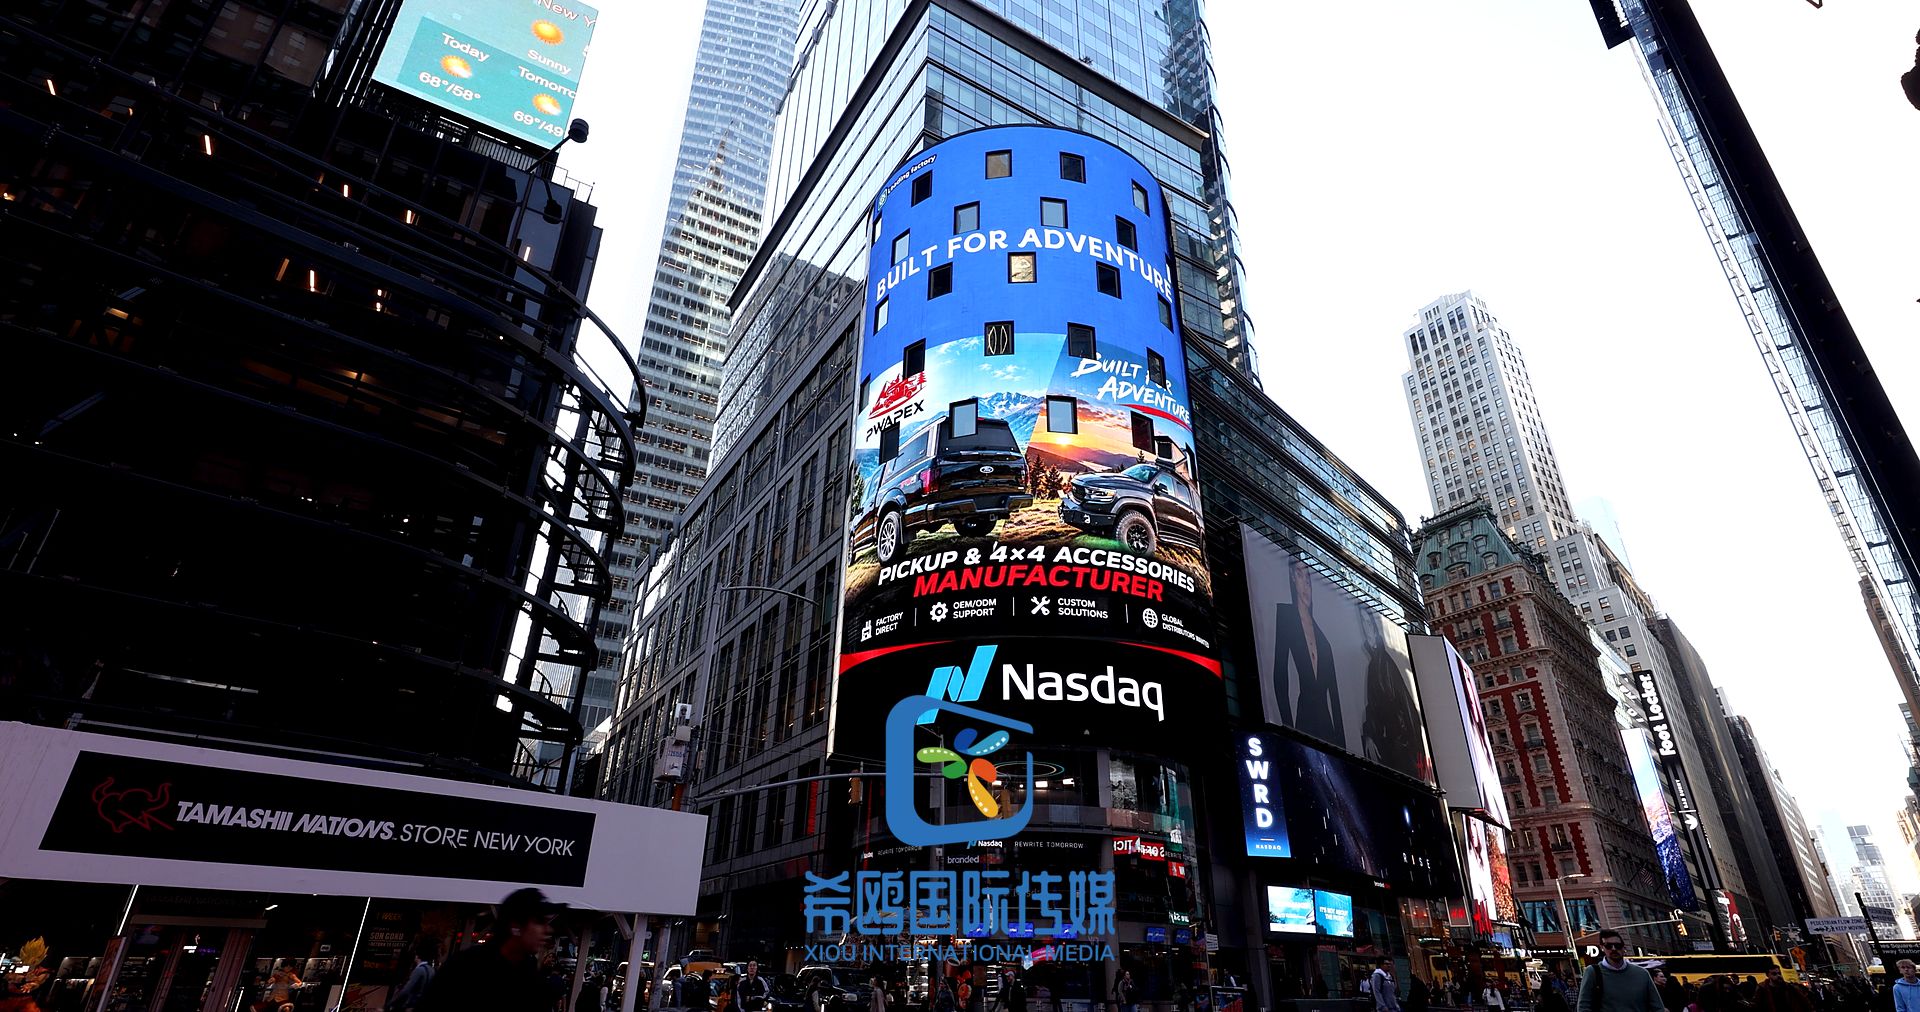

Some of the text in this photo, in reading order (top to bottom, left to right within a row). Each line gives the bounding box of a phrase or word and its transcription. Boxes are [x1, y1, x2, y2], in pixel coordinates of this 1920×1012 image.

[537, 0, 579, 20] New
[442, 33, 490, 62] Today
[527, 49, 571, 75] Sunny
[418, 71, 481, 101] 68°/58°
[911, 155, 936, 173] factory
[876, 228, 1173, 303] BUILT FOR ADVENTURE
[1096, 376, 1190, 424] ADVENTURE
[877, 550, 958, 586] PICKUP
[964, 548, 981, 566] &
[1052, 545, 1195, 593] ACCESSORIES
[913, 564, 1165, 602] MANUFACTURER
[953, 598, 997, 609] OEM/ODM
[953, 607, 994, 618] SUPPORT
[1057, 598, 1096, 608] CUSTOM
[1058, 607, 1109, 619] SOLUTIONS
[876, 612, 903, 626] FACTORY
[876, 622, 898, 635] DIRECT
[1162, 614, 1183, 627] GLOBAL
[1002, 663, 1165, 722] Nasdaq
[1639, 673, 1676, 756] Foot Locker
[1246, 737, 1273, 828] SWRD
[176, 801, 576, 857] TAMASHII NATIONS STORE NEW YORK
[978, 840, 1003, 848] Nasdaq
[1046, 841, 1084, 849] TOMORROW
